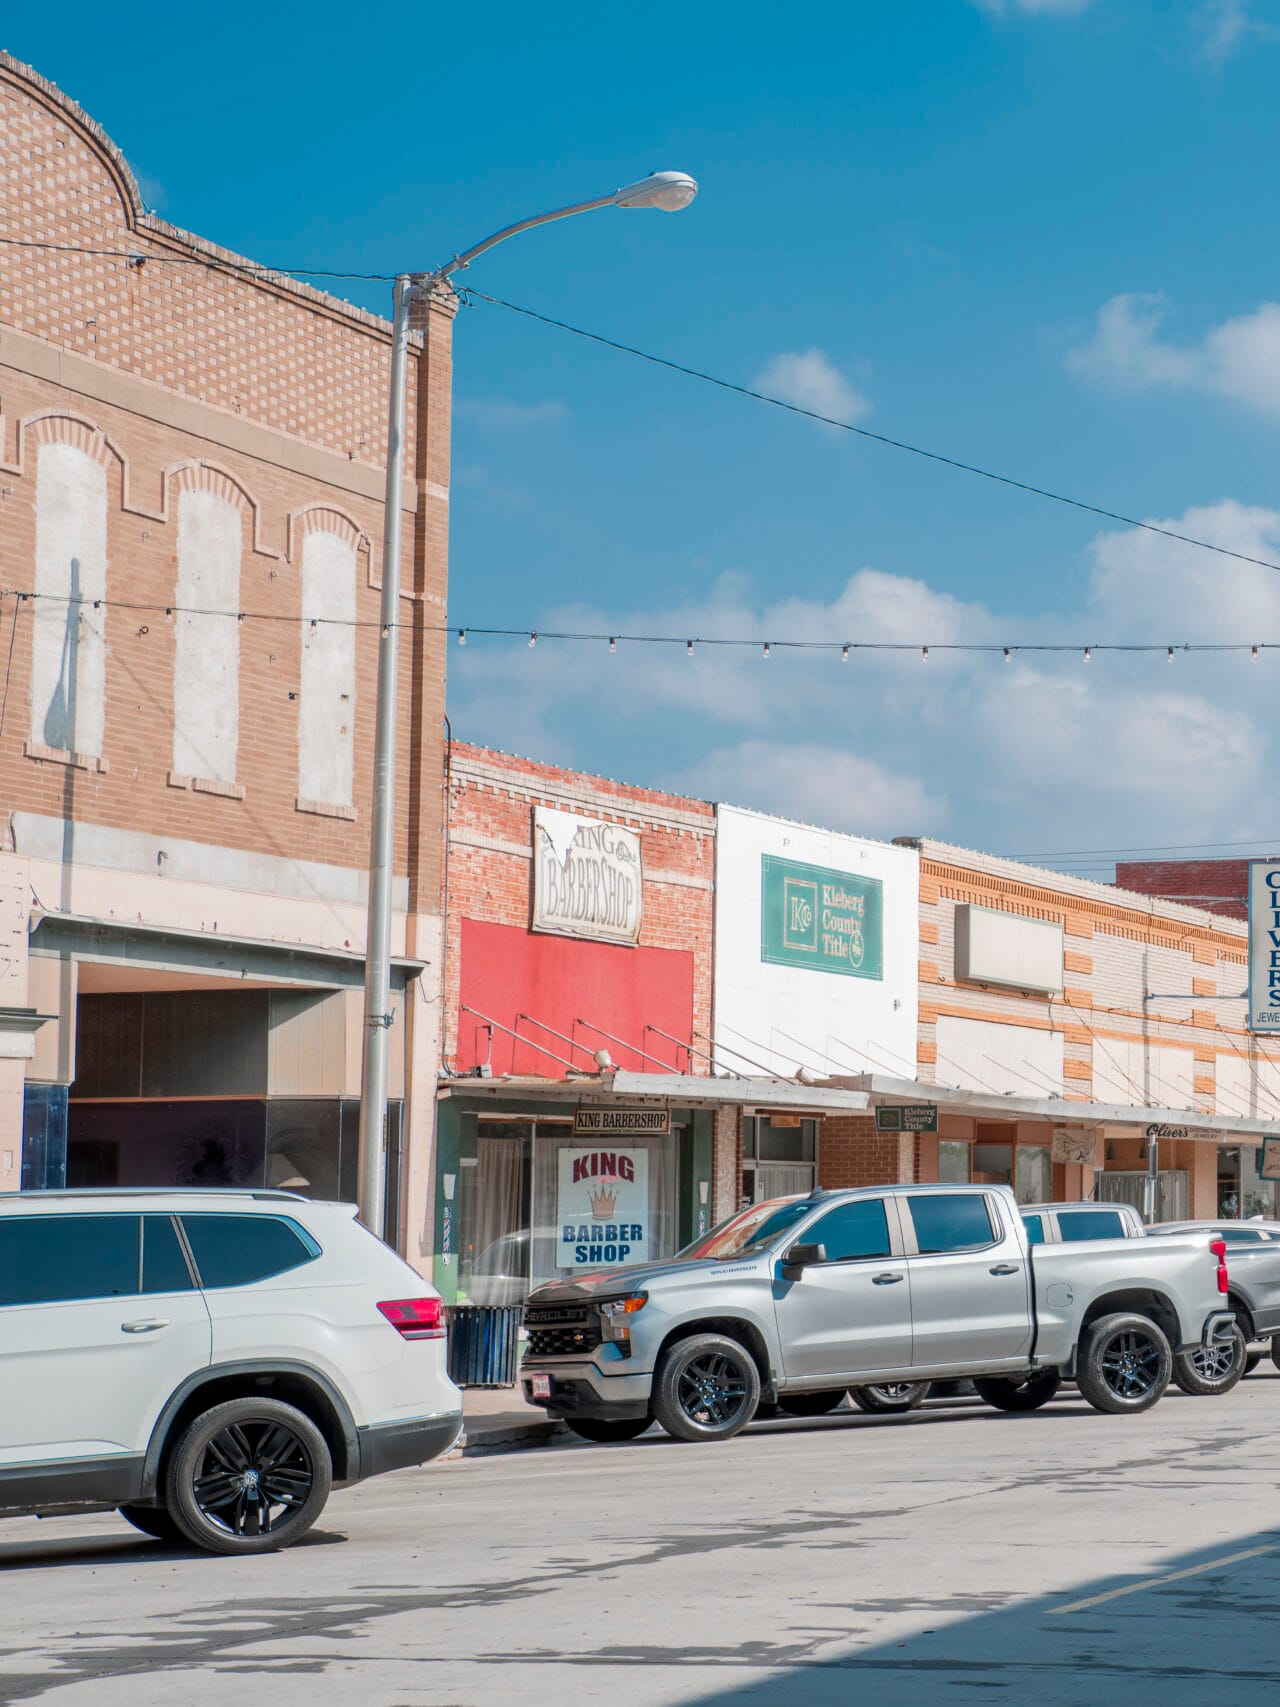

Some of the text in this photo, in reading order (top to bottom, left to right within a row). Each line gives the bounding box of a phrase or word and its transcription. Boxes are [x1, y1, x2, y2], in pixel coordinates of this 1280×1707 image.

[546, 856, 633, 929] BARBERSHOP
[822, 884, 865, 918] Kleberg
[822, 908, 863, 935] County
[822, 933, 849, 958] Title
[577, 1112, 666, 1129] KING BARBERSHOP
[904, 1107, 936, 1117] Kleberg
[904, 1115, 933, 1124] County
[904, 1122, 924, 1130] Title
[1145, 1123, 1189, 1138] Oliver's
[573, 1151, 634, 1184] KING
[562, 1223, 643, 1243] BARBER
[575, 1244, 631, 1263] SHOP
